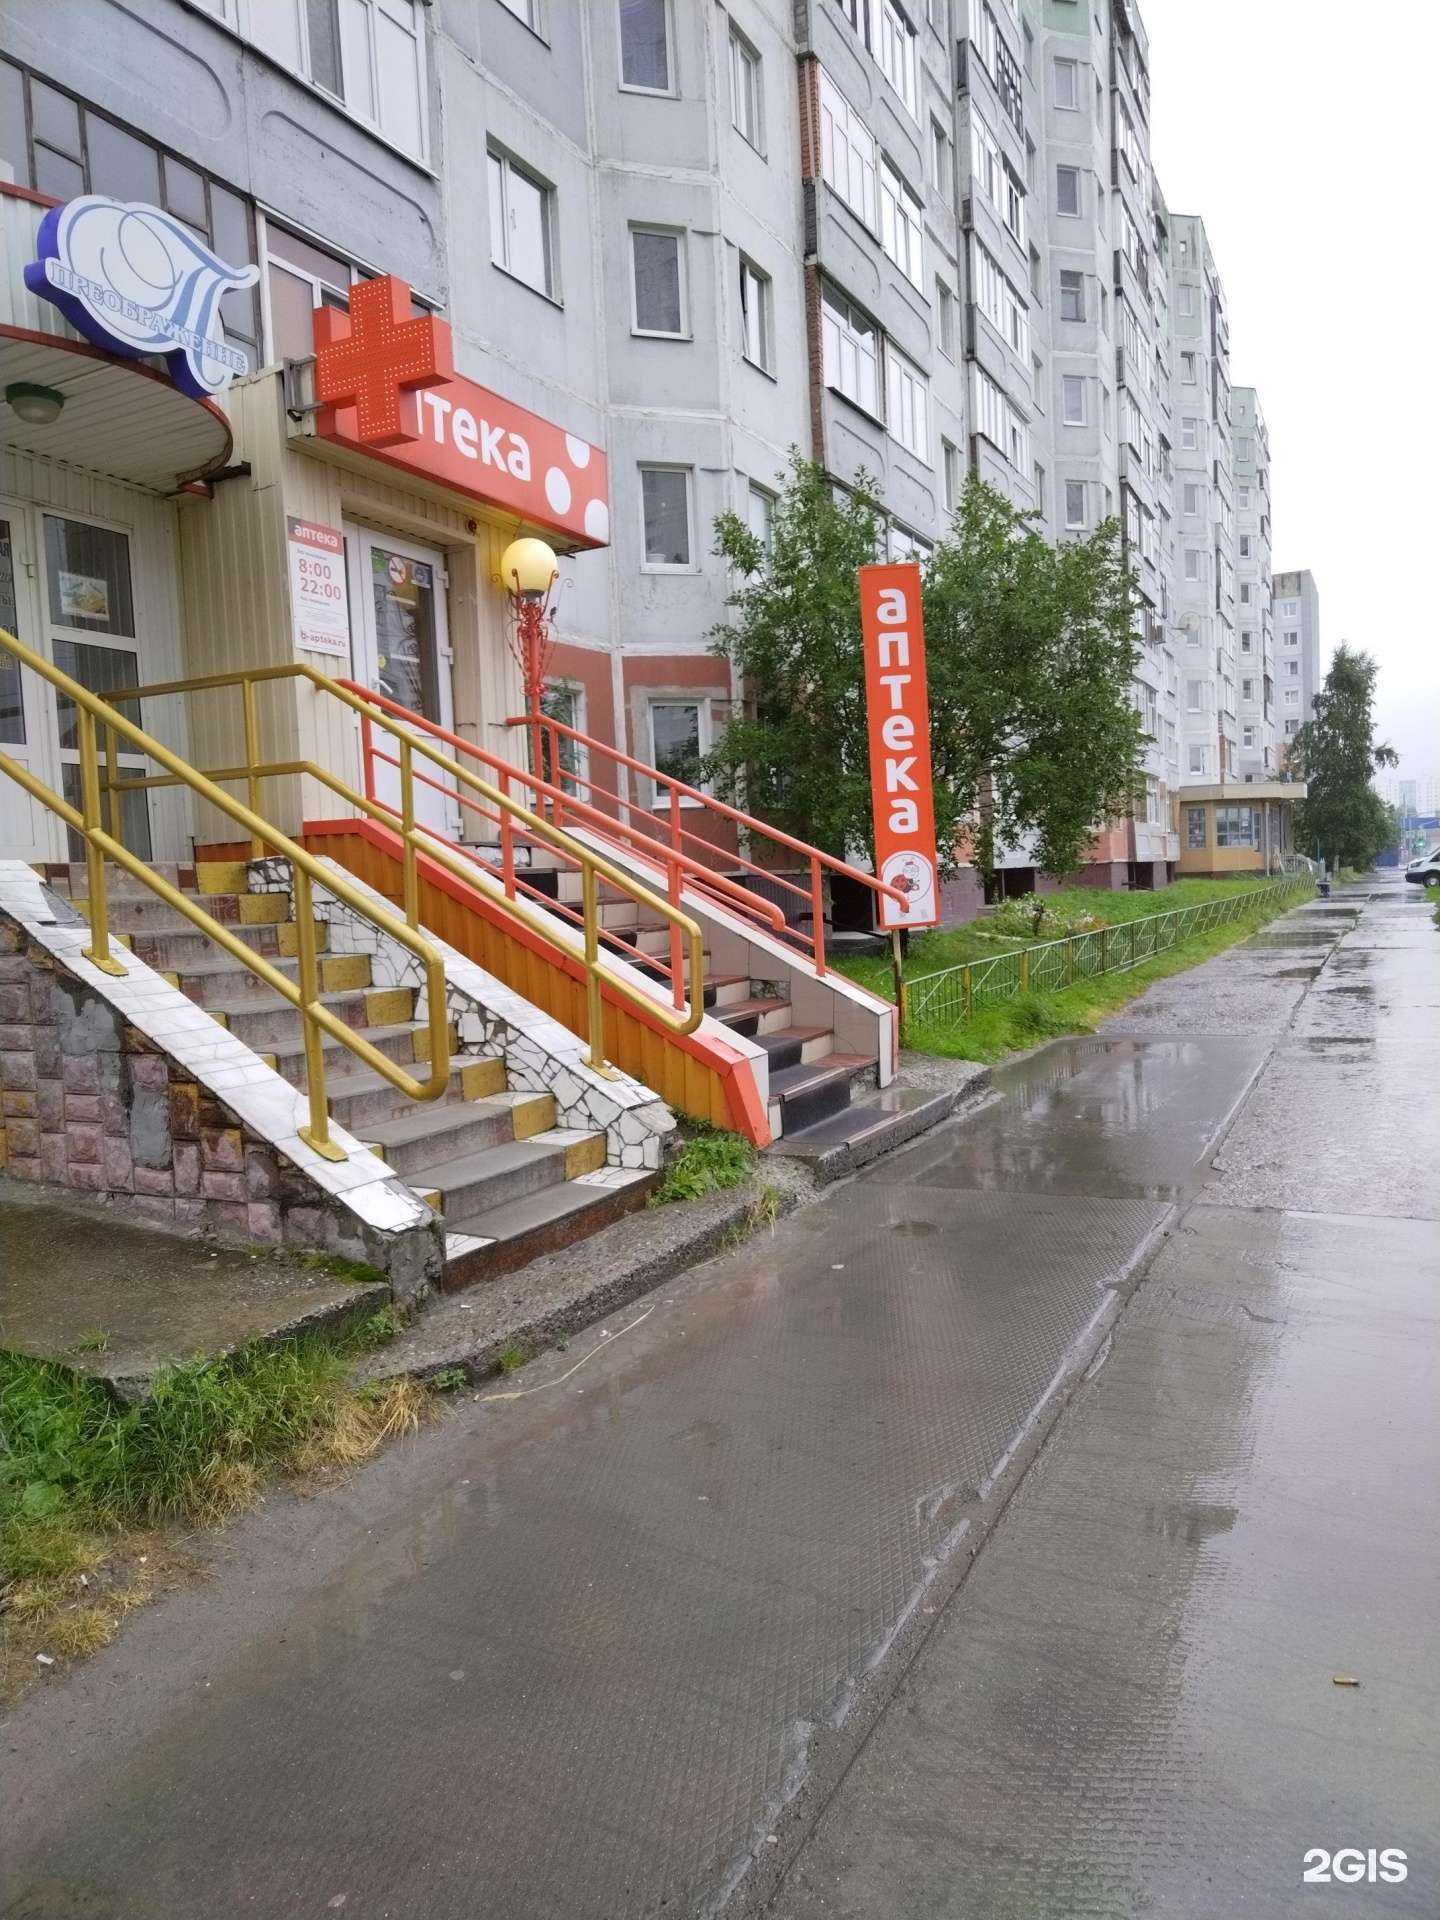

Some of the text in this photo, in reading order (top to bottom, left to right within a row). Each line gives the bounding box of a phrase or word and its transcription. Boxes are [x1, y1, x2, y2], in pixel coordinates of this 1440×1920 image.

[50, 262, 247, 373] ПРЕОБРАЖЕНИЕ
[415, 389, 532, 482] тека
[294, 524, 338, 547] аптека
[299, 558, 331, 580] 8:00
[300, 577, 342, 601] 22:00
[876, 588, 919, 834] аптека
